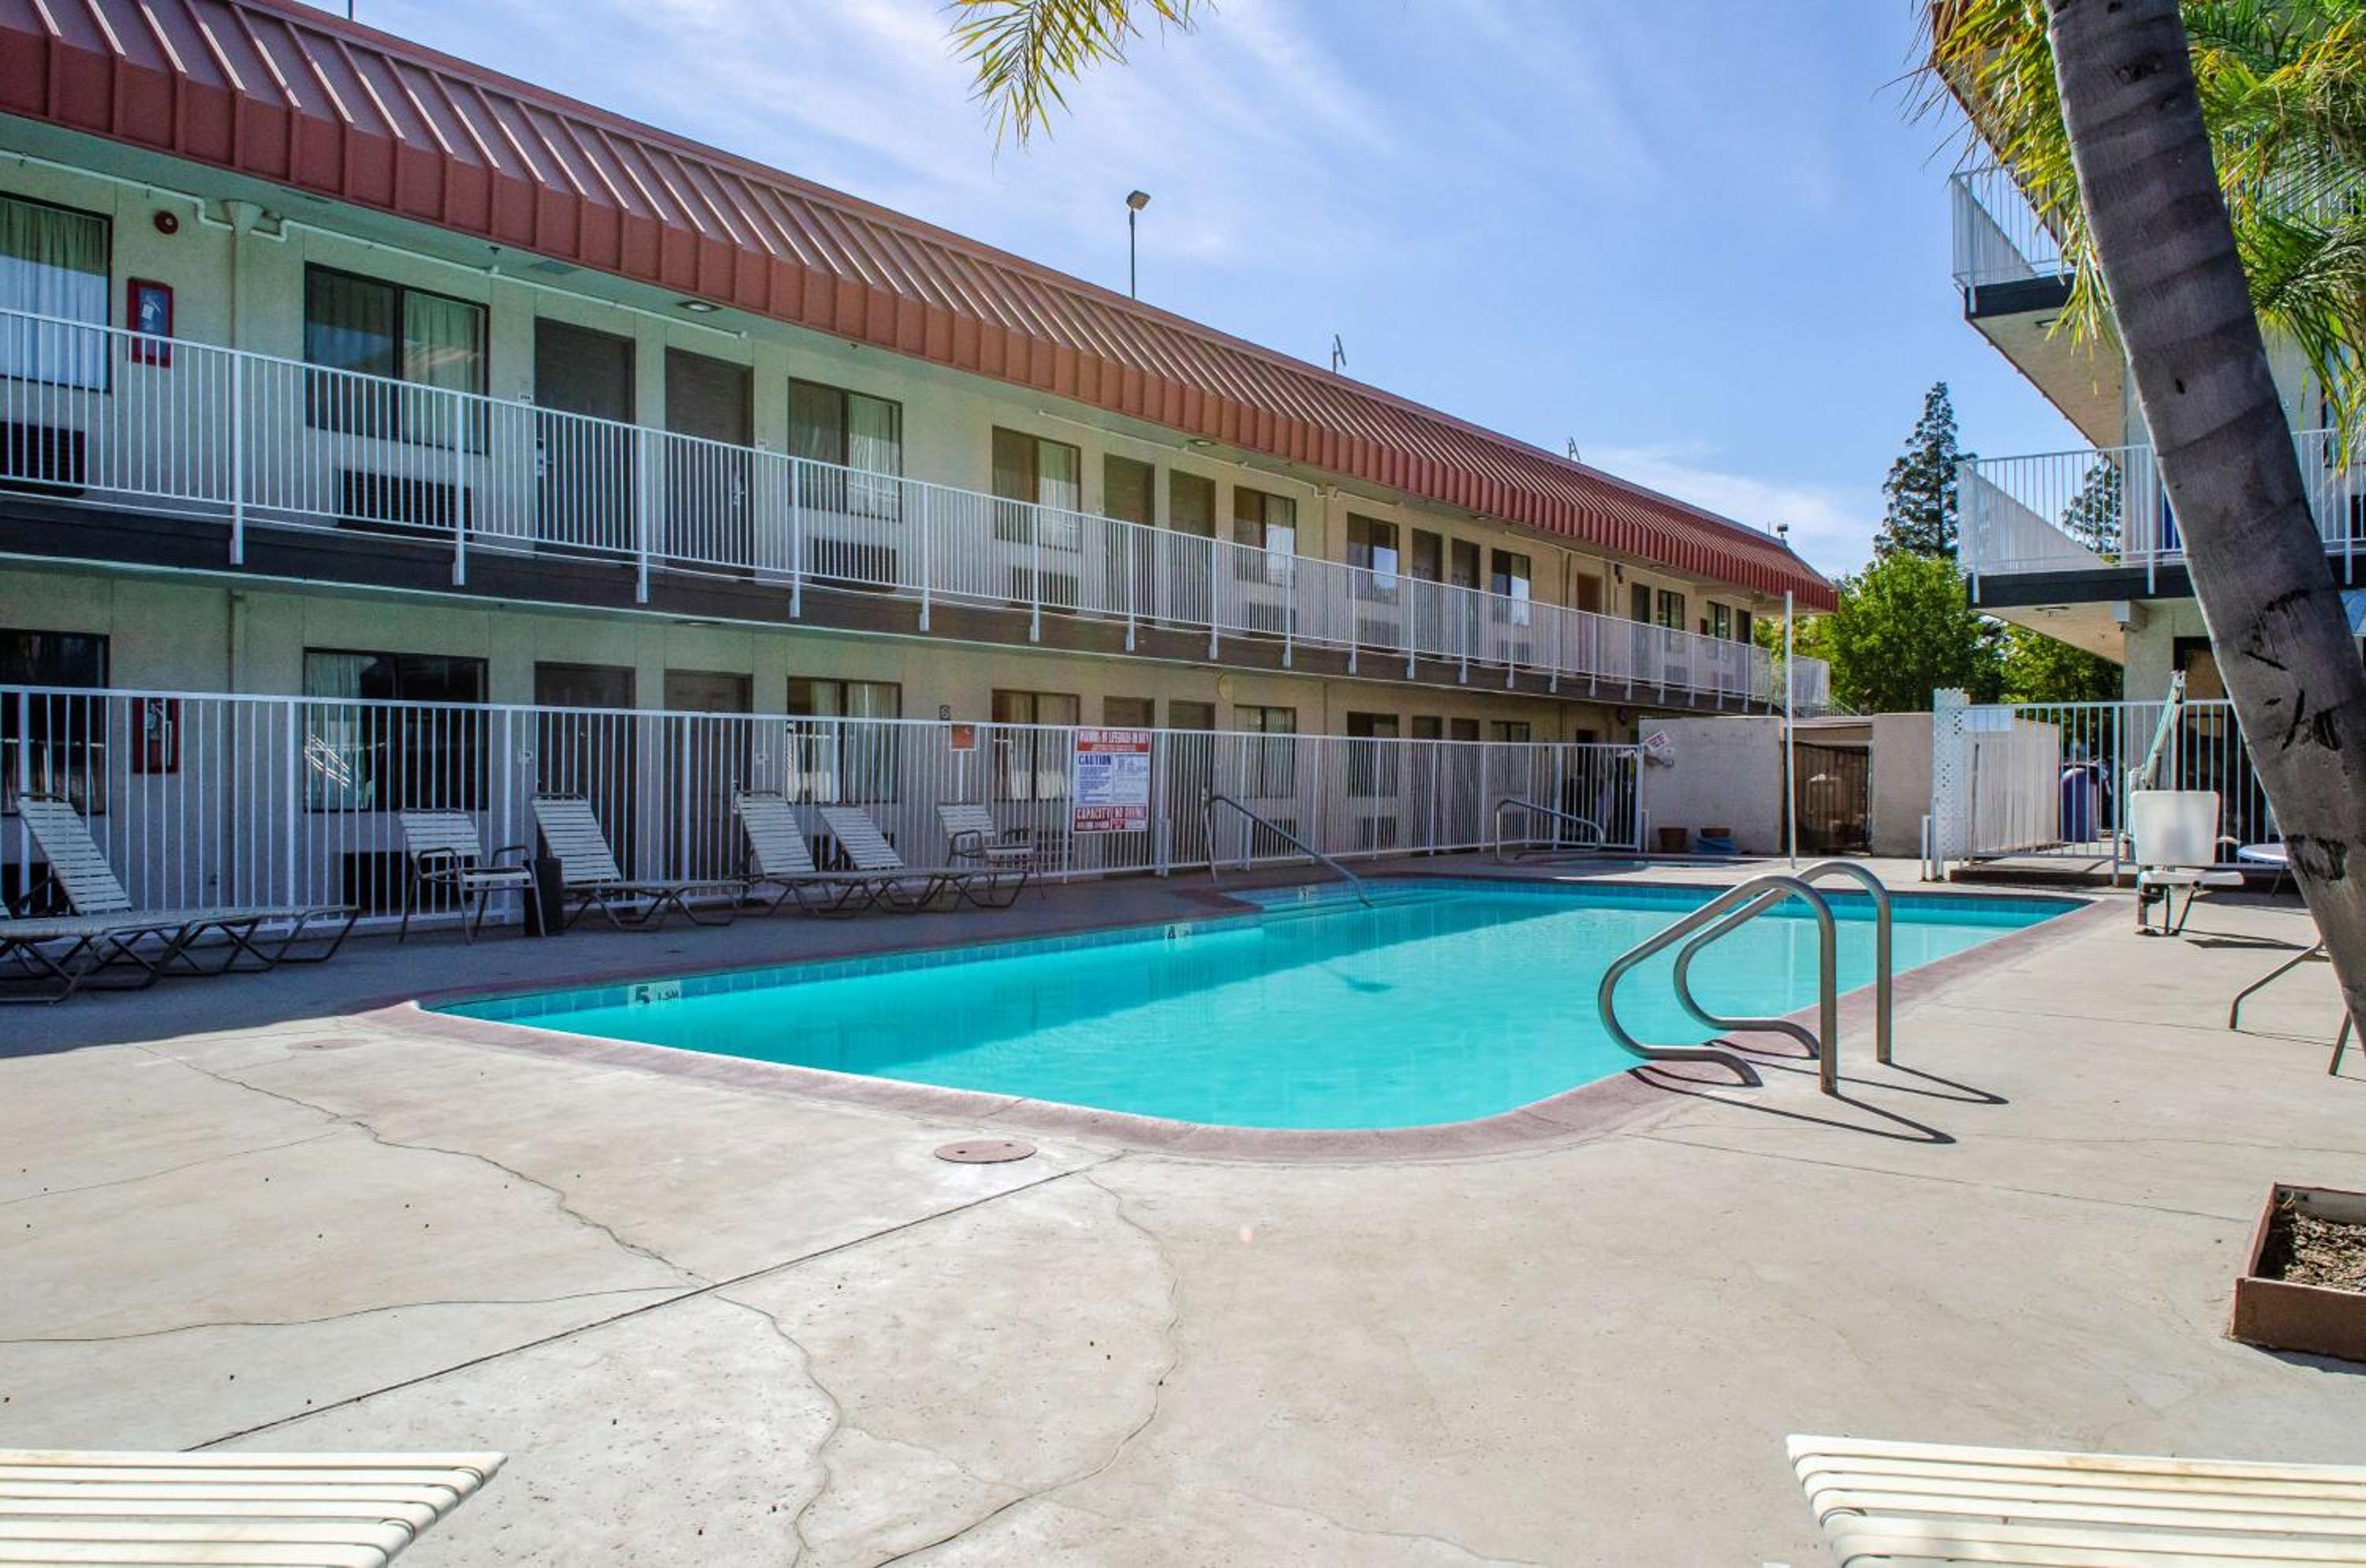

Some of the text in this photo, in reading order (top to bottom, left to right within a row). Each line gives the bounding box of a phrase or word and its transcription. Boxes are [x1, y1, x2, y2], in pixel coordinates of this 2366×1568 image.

[1078, 755, 1111, 765] CAUTION
[1077, 807, 1110, 819] CAPACITY
[636, 985, 650, 1003] 5
